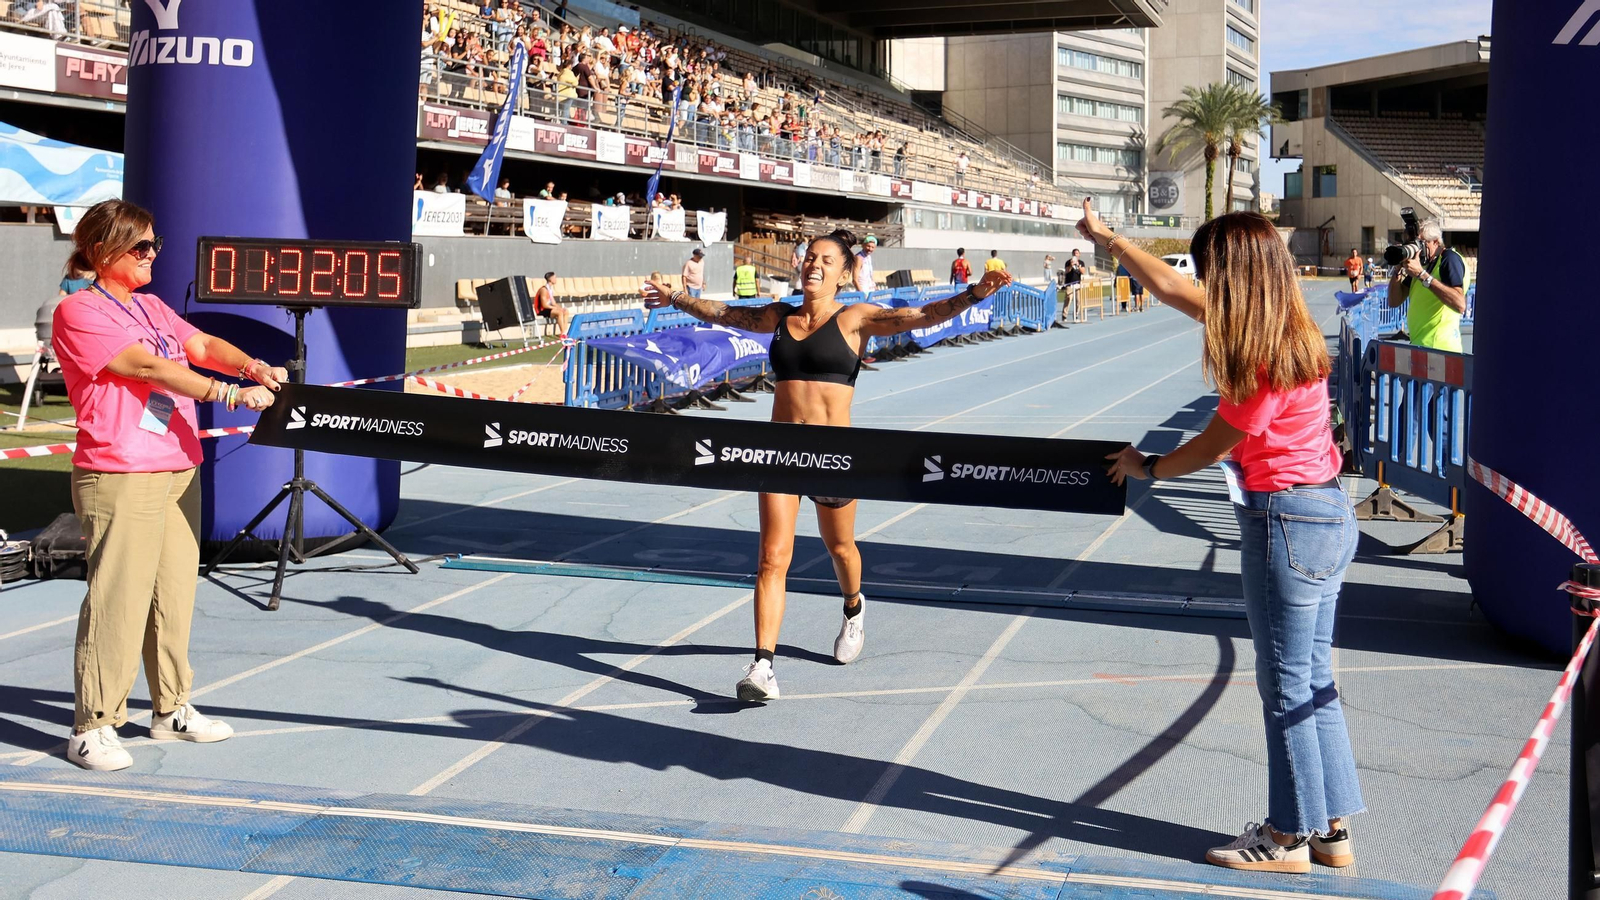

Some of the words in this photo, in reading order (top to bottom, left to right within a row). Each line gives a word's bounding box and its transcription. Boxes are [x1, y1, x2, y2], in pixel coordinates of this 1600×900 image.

[128, 29, 254, 67] MIZUNO
[66, 57, 122, 83] PLAY
[426, 112, 455, 129] PLAY
[537, 129, 563, 144] PLAY
[627, 143, 647, 157] PLAY
[1150, 186, 1178, 198] B&B
[423, 211, 463, 224] JEREZ2031
[210, 246, 402, 299] 01:32:05
[310, 412, 425, 437] SPORTMADNESS
[507, 429, 629, 454] SPORTMADNESS
[720, 446, 852, 471] SPORTMADNESS
[950, 463, 1091, 486] SPORTMADNESS
